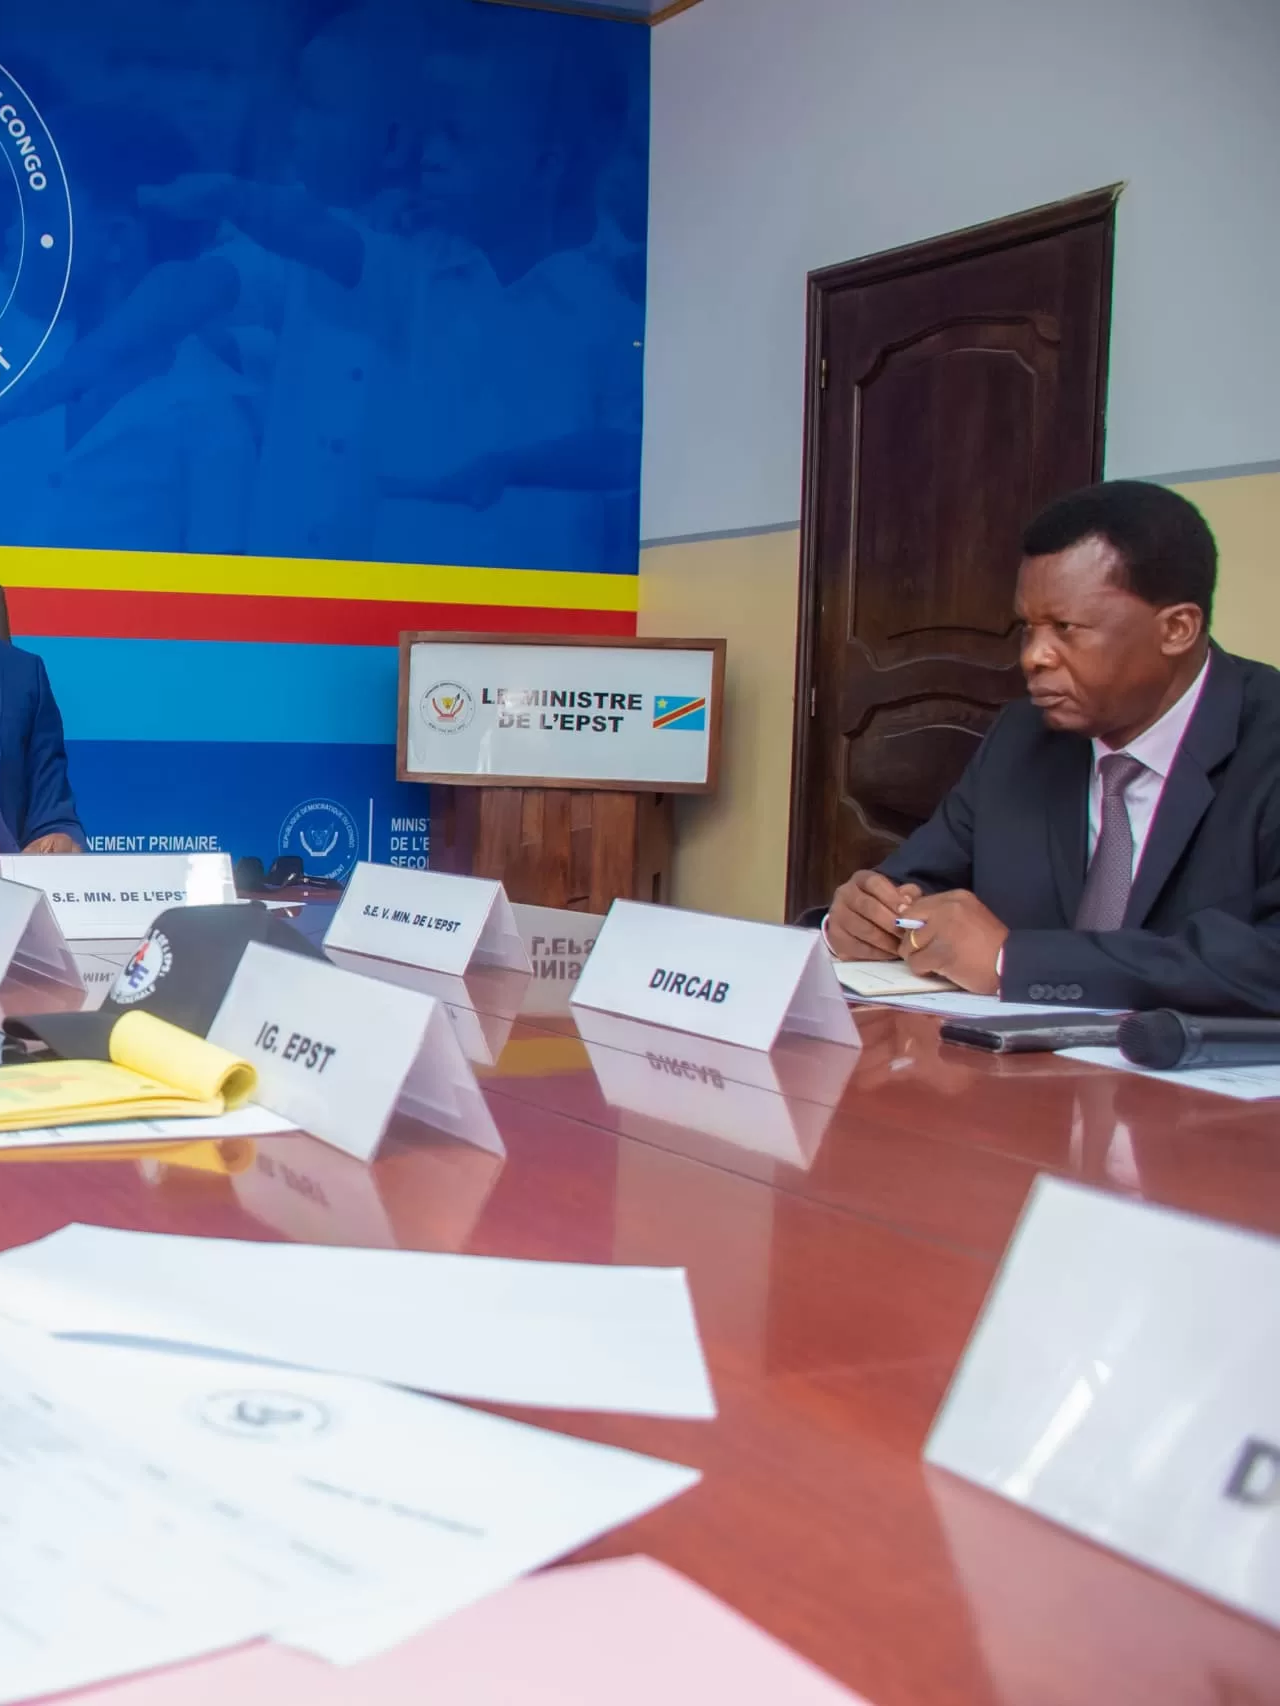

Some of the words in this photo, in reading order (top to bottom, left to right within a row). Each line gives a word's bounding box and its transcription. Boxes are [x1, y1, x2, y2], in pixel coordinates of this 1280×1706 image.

[521, 689, 643, 711] MINISTRE
[499, 711, 531, 729] DE
[539, 712, 625, 733] L'EPST
[148, 836, 222, 853] PRIMAIRE,
[390, 837, 408, 851] DE
[390, 855, 429, 870] SECO
[52, 892, 80, 903] S.E.
[83, 892, 116, 902] MIN.
[120, 891, 140, 902] DE
[143, 890, 188, 902] L'EPS
[362, 904, 379, 918] S.E.
[381, 908, 390, 919] V.
[391, 910, 411, 924] MIN.
[412, 913, 426, 927] DE
[427, 915, 462, 934] L'EPST
[649, 967, 731, 1004] DIRCAB
[254, 1020, 280, 1054] IG.
[281, 1031, 337, 1074] EPST
